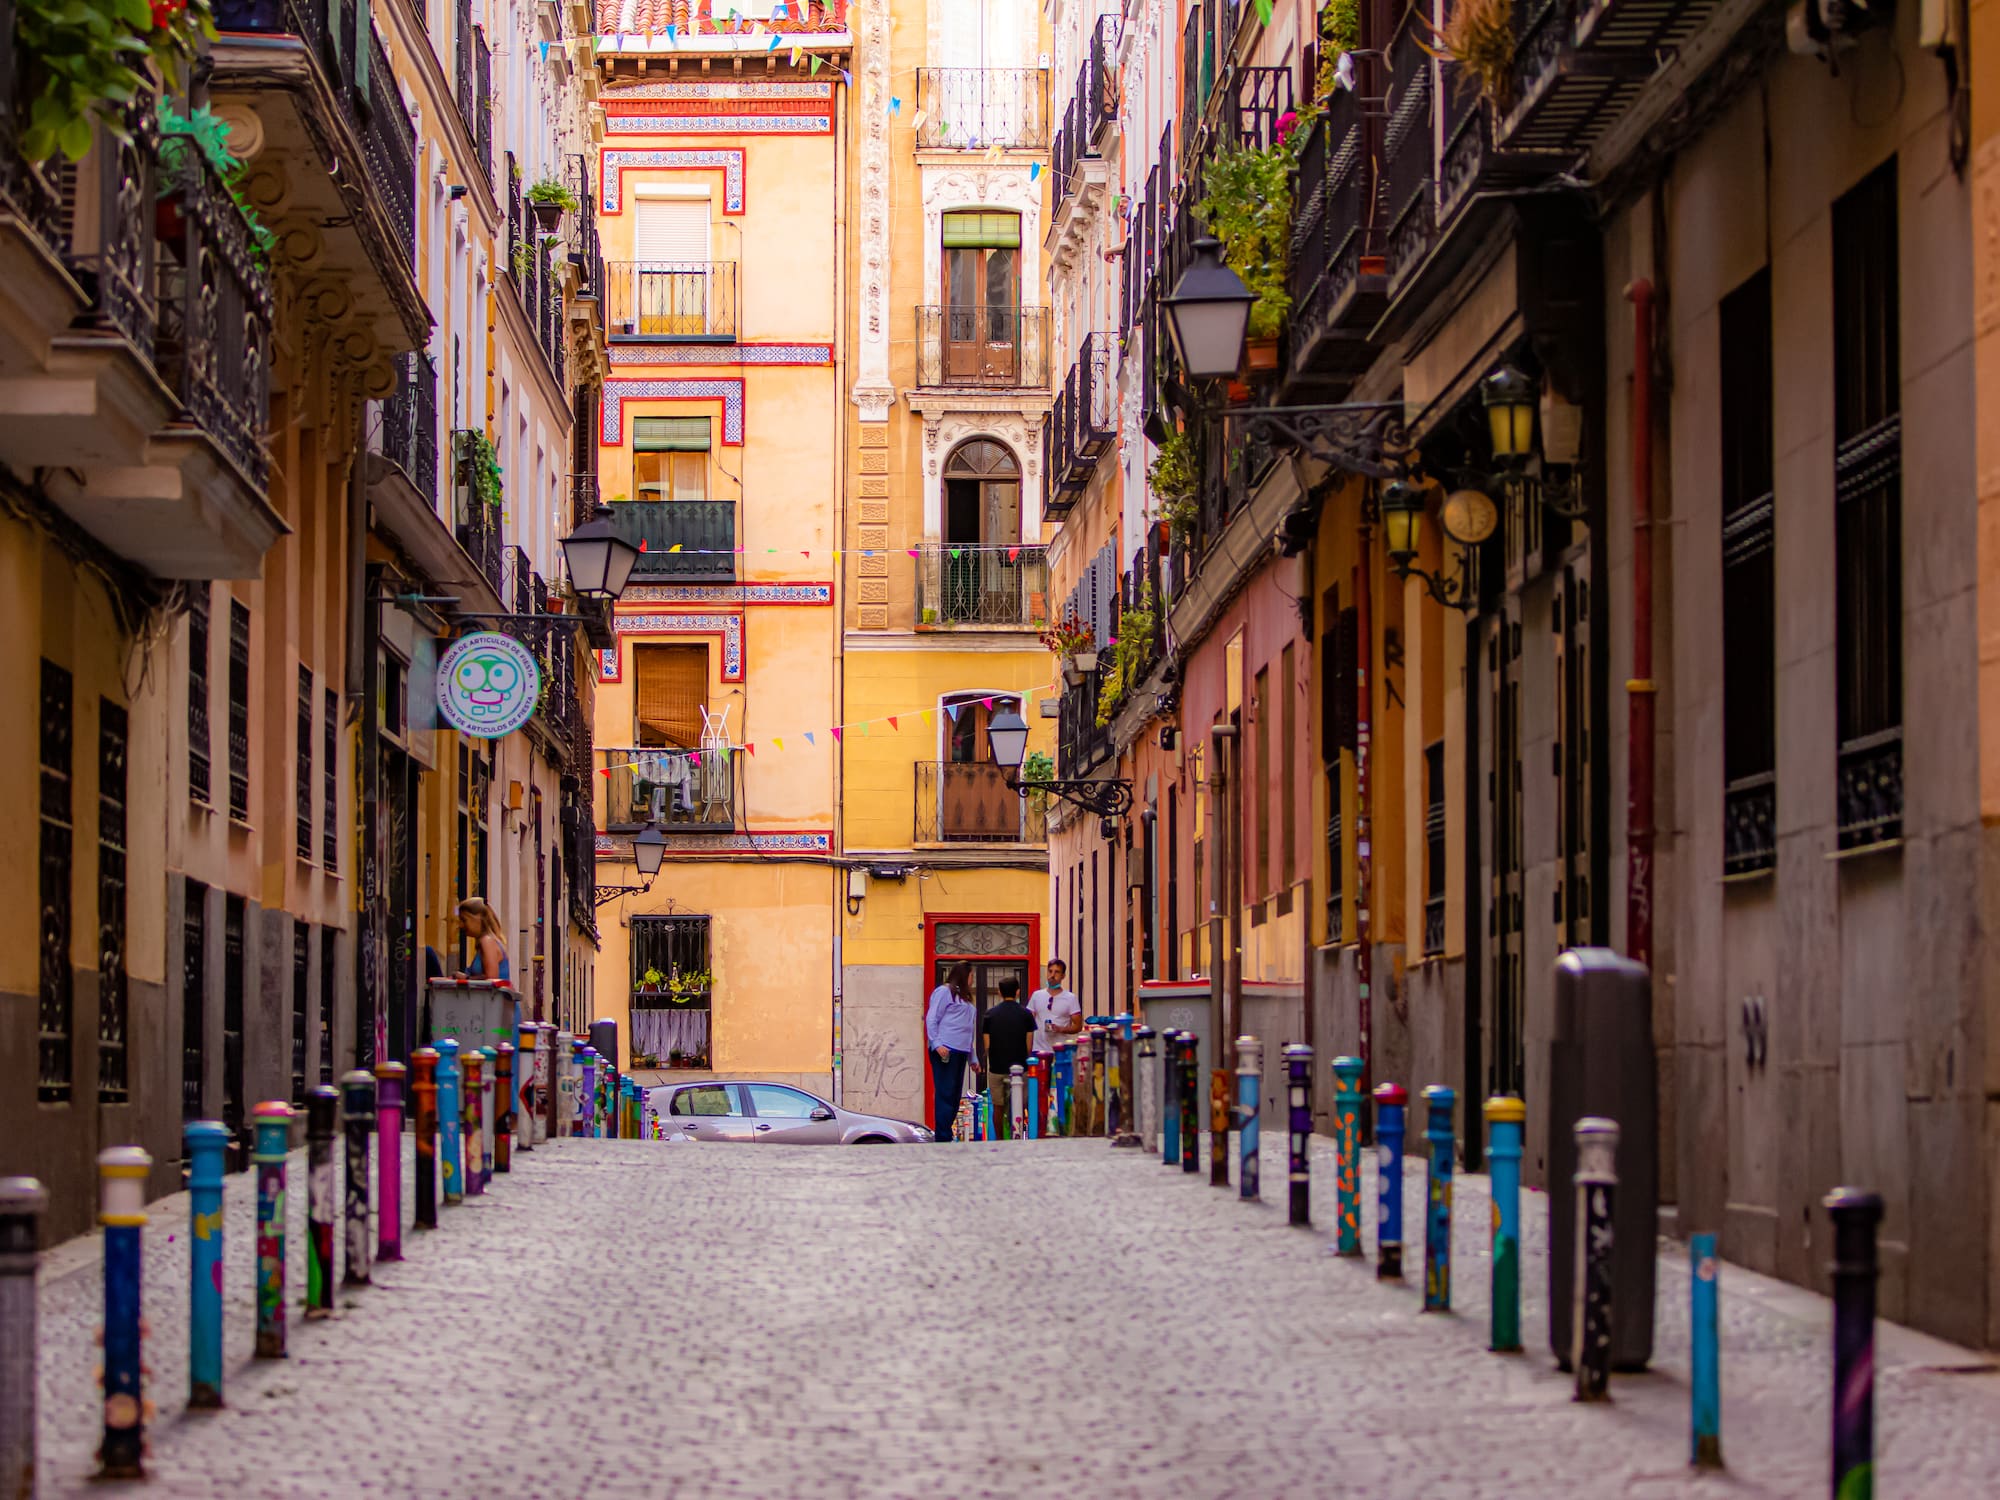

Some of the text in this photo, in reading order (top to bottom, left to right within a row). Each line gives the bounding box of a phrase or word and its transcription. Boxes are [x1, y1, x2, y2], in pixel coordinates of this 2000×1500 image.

[442, 637, 534, 678] TIENDA DE ARTICULOS DE FIESTA
[441, 693, 533, 733] TIENDA DE ARTICULOS DE FIESTA
